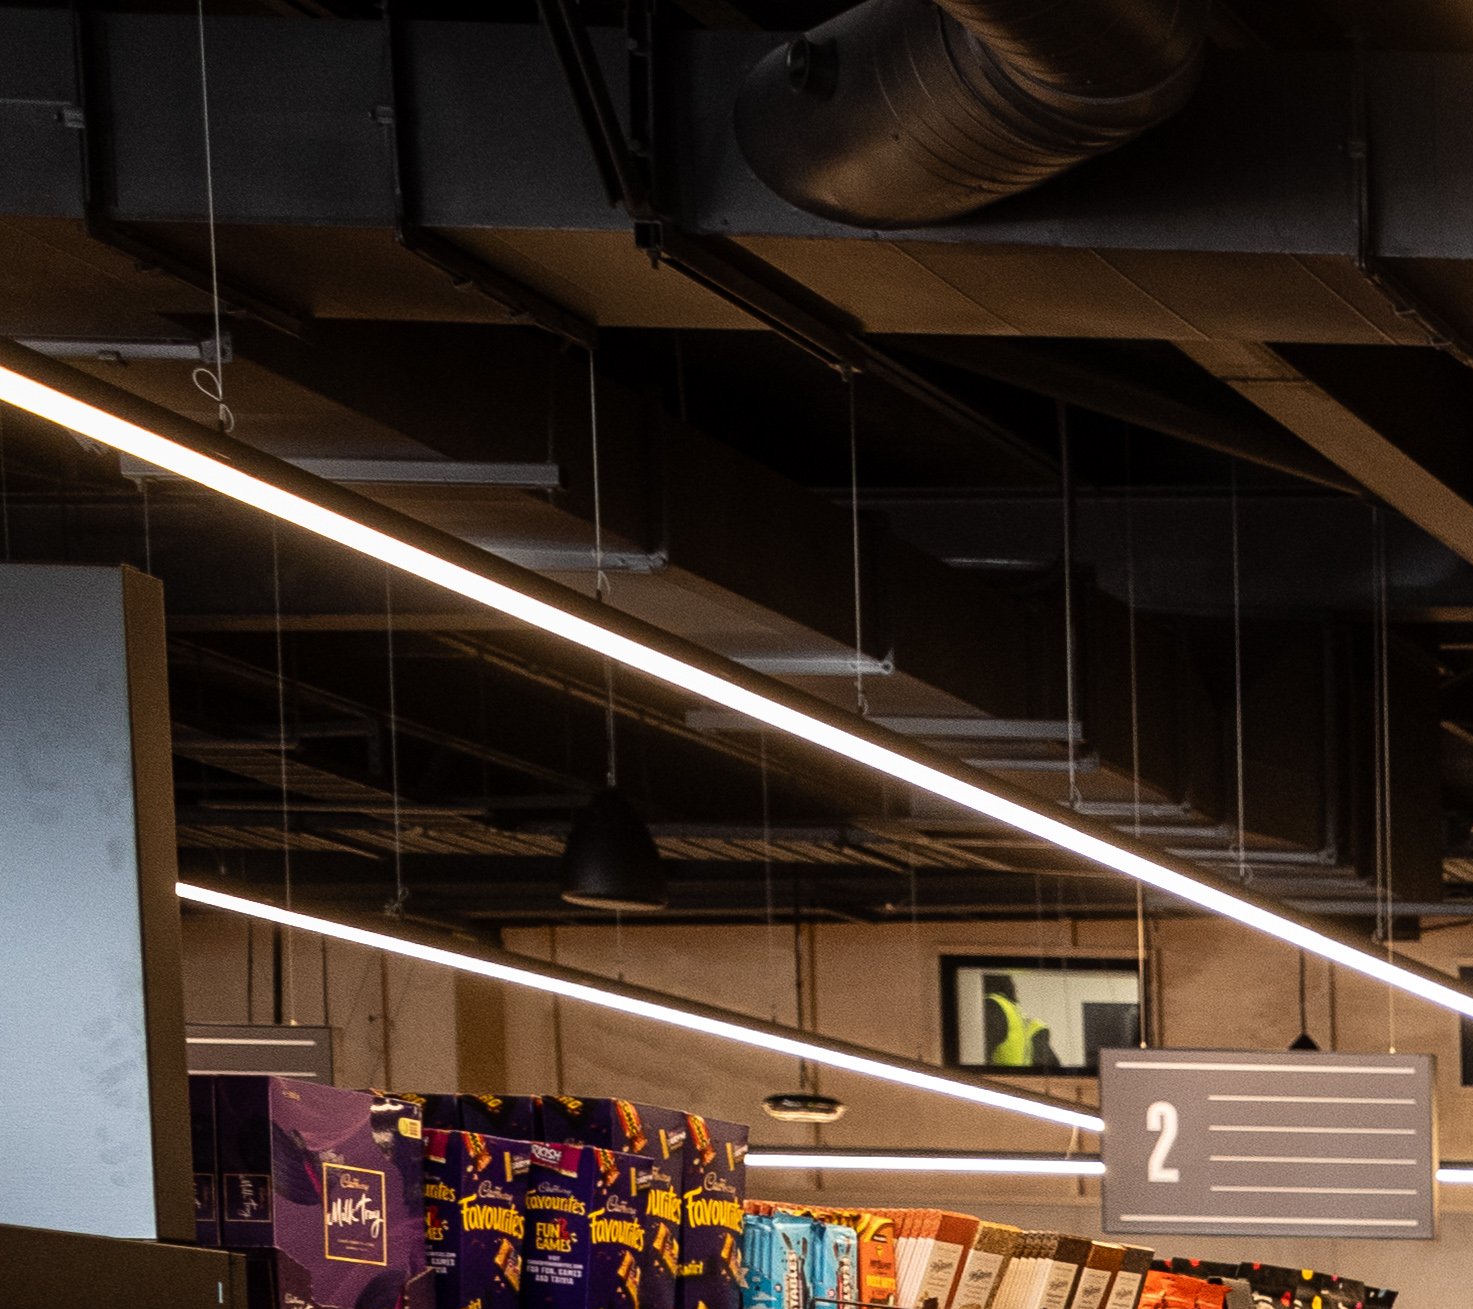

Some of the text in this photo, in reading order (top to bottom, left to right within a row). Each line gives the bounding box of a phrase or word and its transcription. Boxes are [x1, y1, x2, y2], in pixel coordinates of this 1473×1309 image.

[1145, 1101, 1180, 1183] 2
[458, 1194, 525, 1240] Favourites
[647, 1186, 682, 1226] urites
[683, 1187, 744, 1234] Favourites
[536, 1223, 560, 1237] FUN
[536, 1237, 571, 1252] GAMES
[588, 1209, 645, 1251] Favourites
